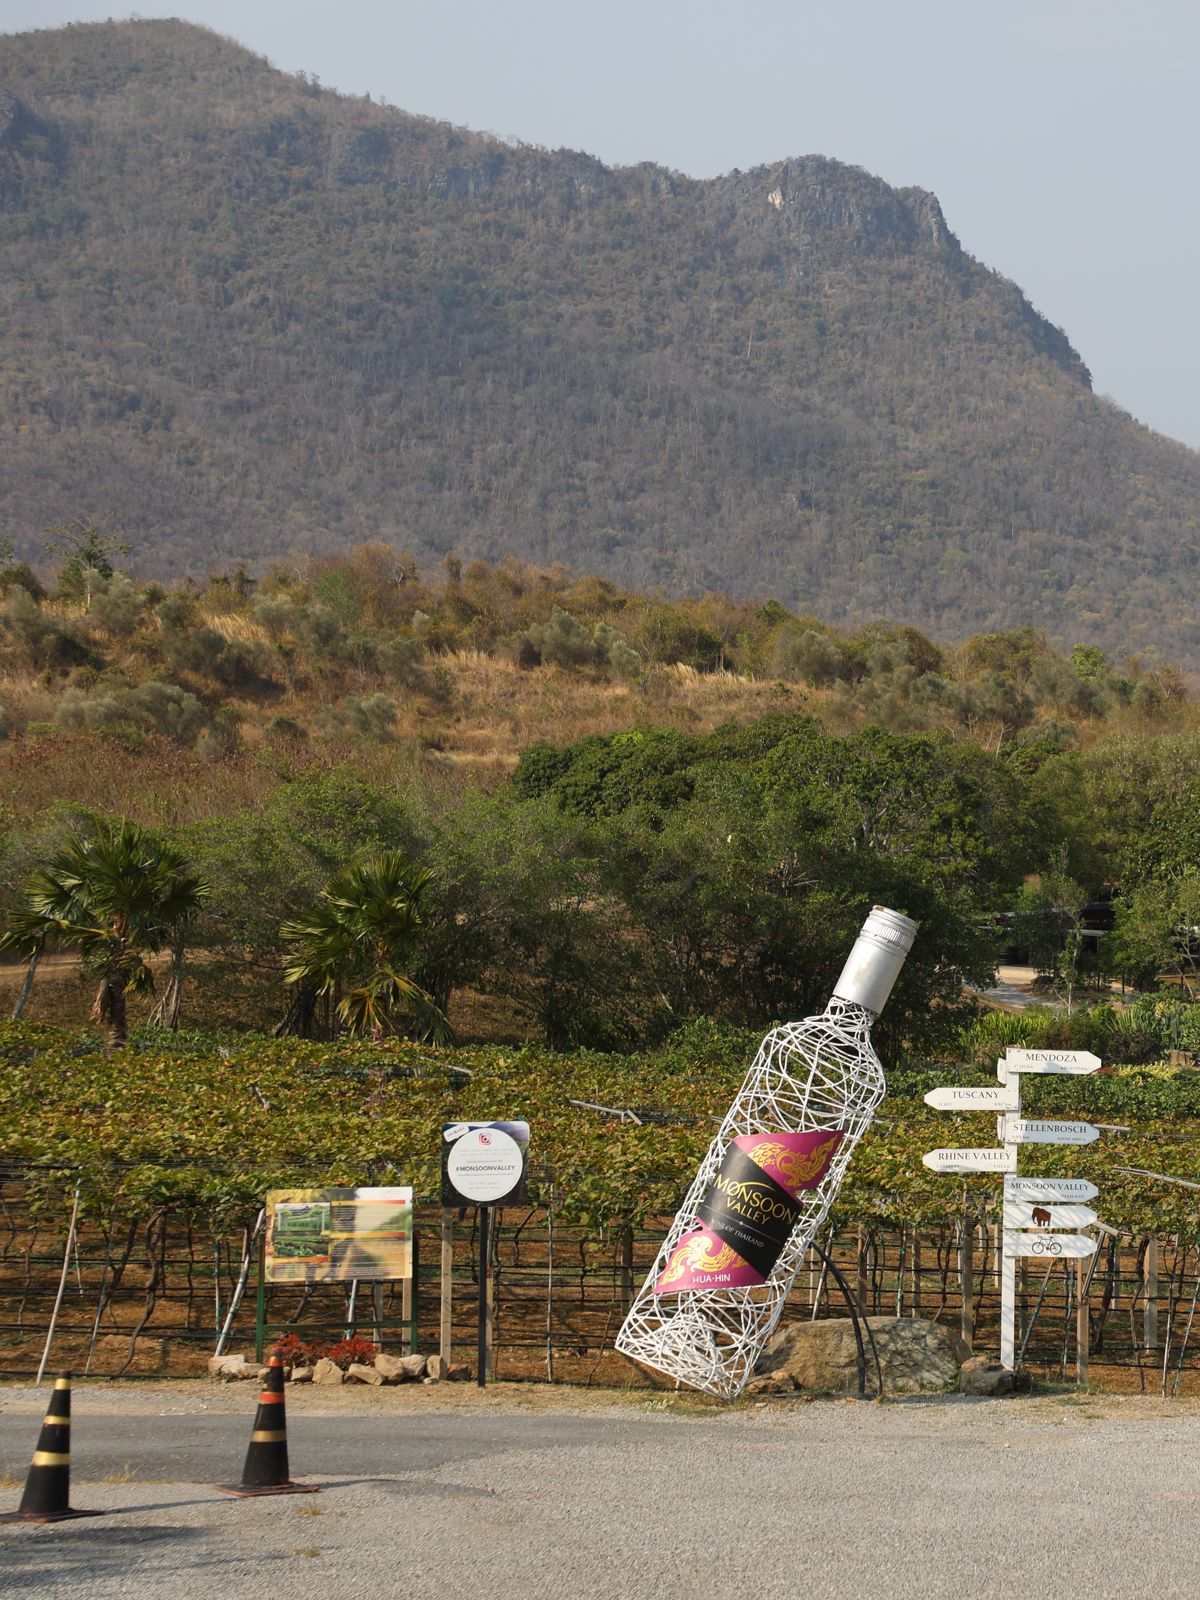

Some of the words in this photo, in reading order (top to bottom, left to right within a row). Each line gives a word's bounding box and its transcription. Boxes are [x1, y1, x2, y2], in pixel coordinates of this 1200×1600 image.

[1025, 1053, 1078, 1063] MENDOZA
[952, 1091, 999, 1099] TUSCANY
[1013, 1124, 1087, 1134] STELLENBOSCH
[938, 1152, 970, 1160] RHINE
[973, 1152, 1011, 1160] VALLEY
[1010, 1182, 1056, 1191] MONSOON
[1057, 1183, 1089, 1191] VALLEY
[726, 1197, 771, 1225] VALLEY
[734, 1230, 765, 1248] THAILAND
[692, 1273, 731, 1284] HUA-HIN
